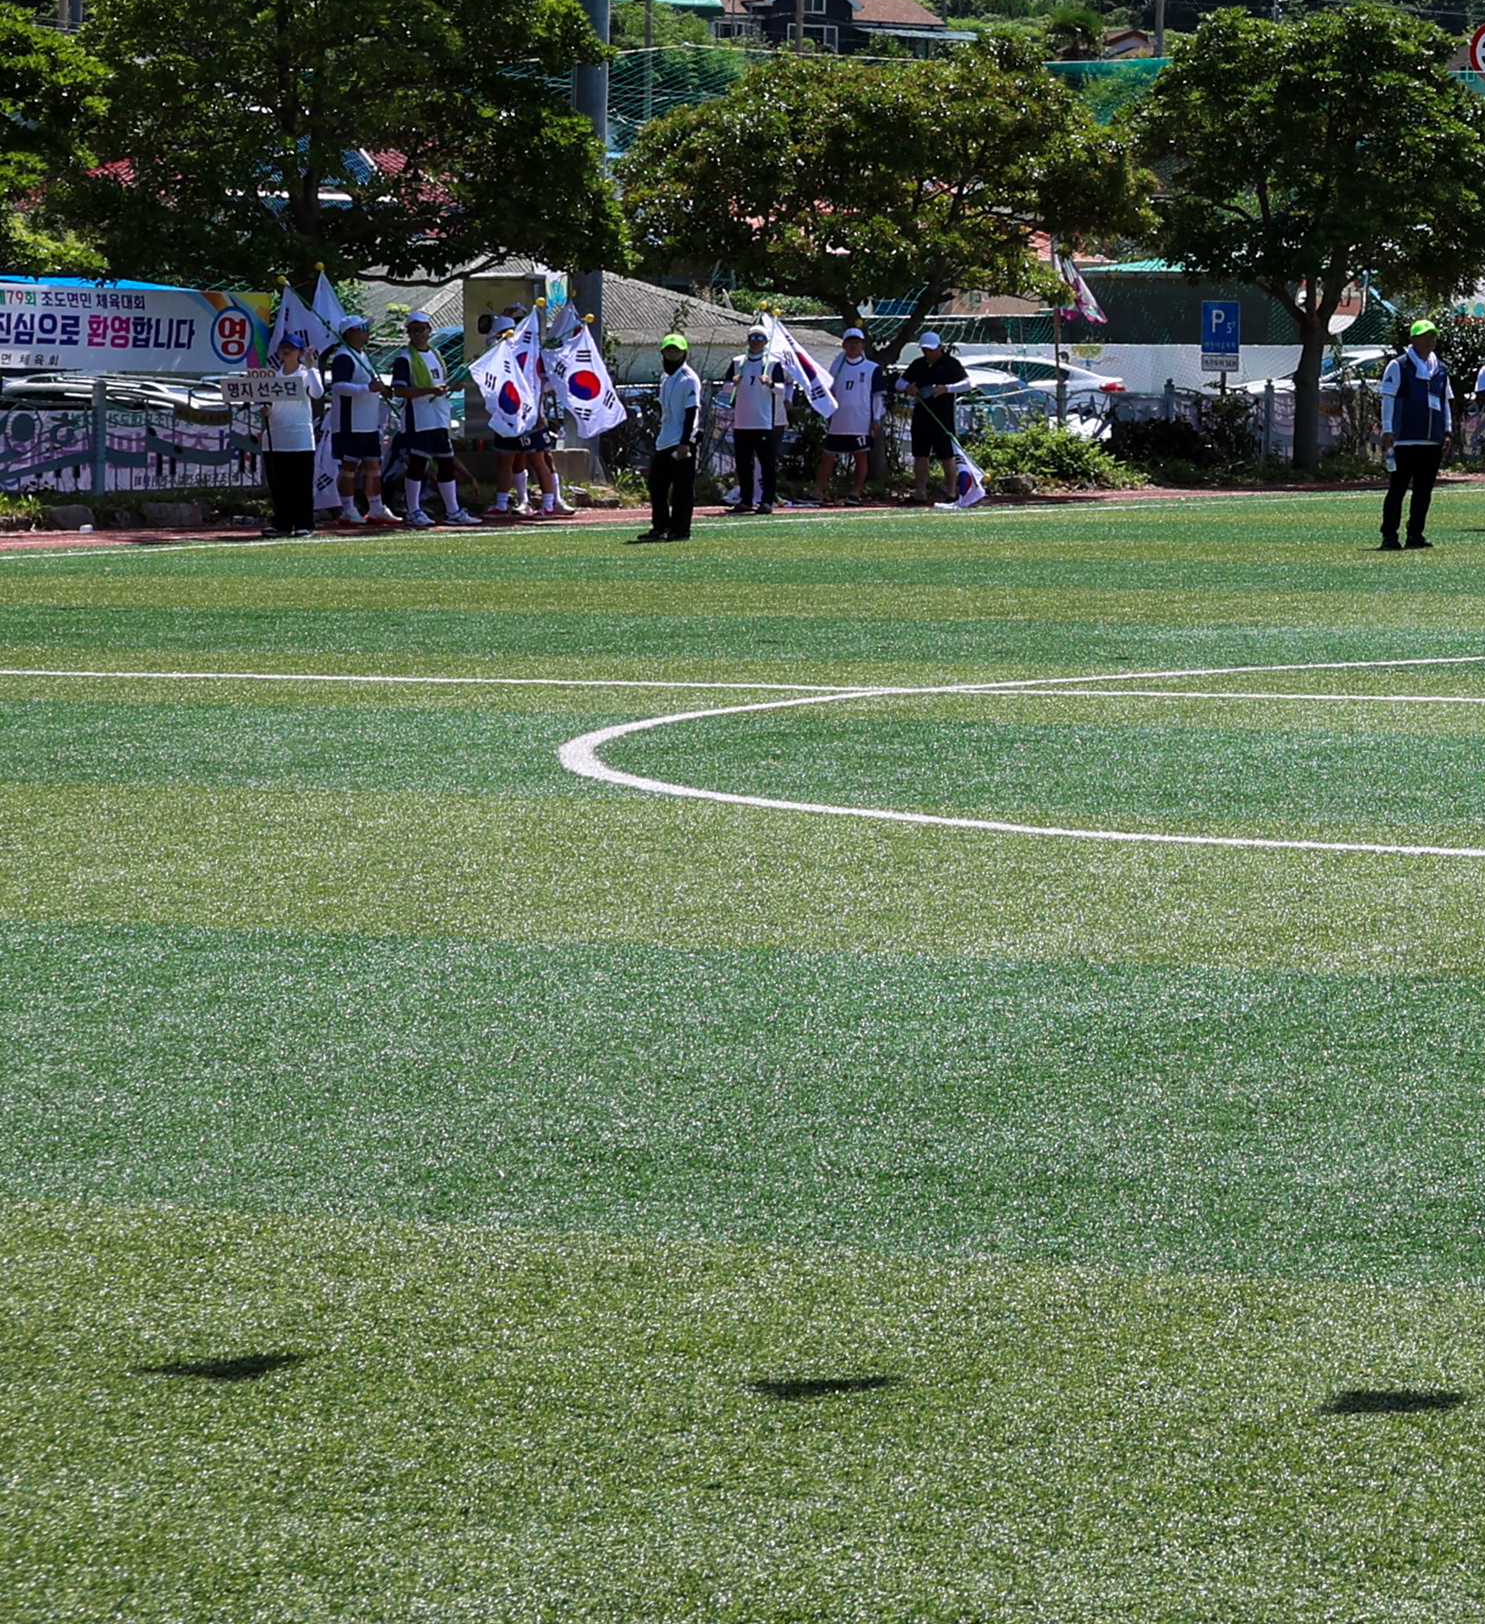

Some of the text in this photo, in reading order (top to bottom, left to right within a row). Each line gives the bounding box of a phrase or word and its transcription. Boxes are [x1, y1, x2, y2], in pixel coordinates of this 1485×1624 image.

[41, 292, 92, 308] 조도면민
[96, 294, 146, 310] 체육대회
[1211, 309, 1225, 333] P
[87, 314, 195, 350] 환영합니다
[217, 317, 247, 356] 영
[18, 354, 60, 366] 체육회
[228, 381, 297, 398] 명지 선수단
[845, 380, 855, 390] 17
